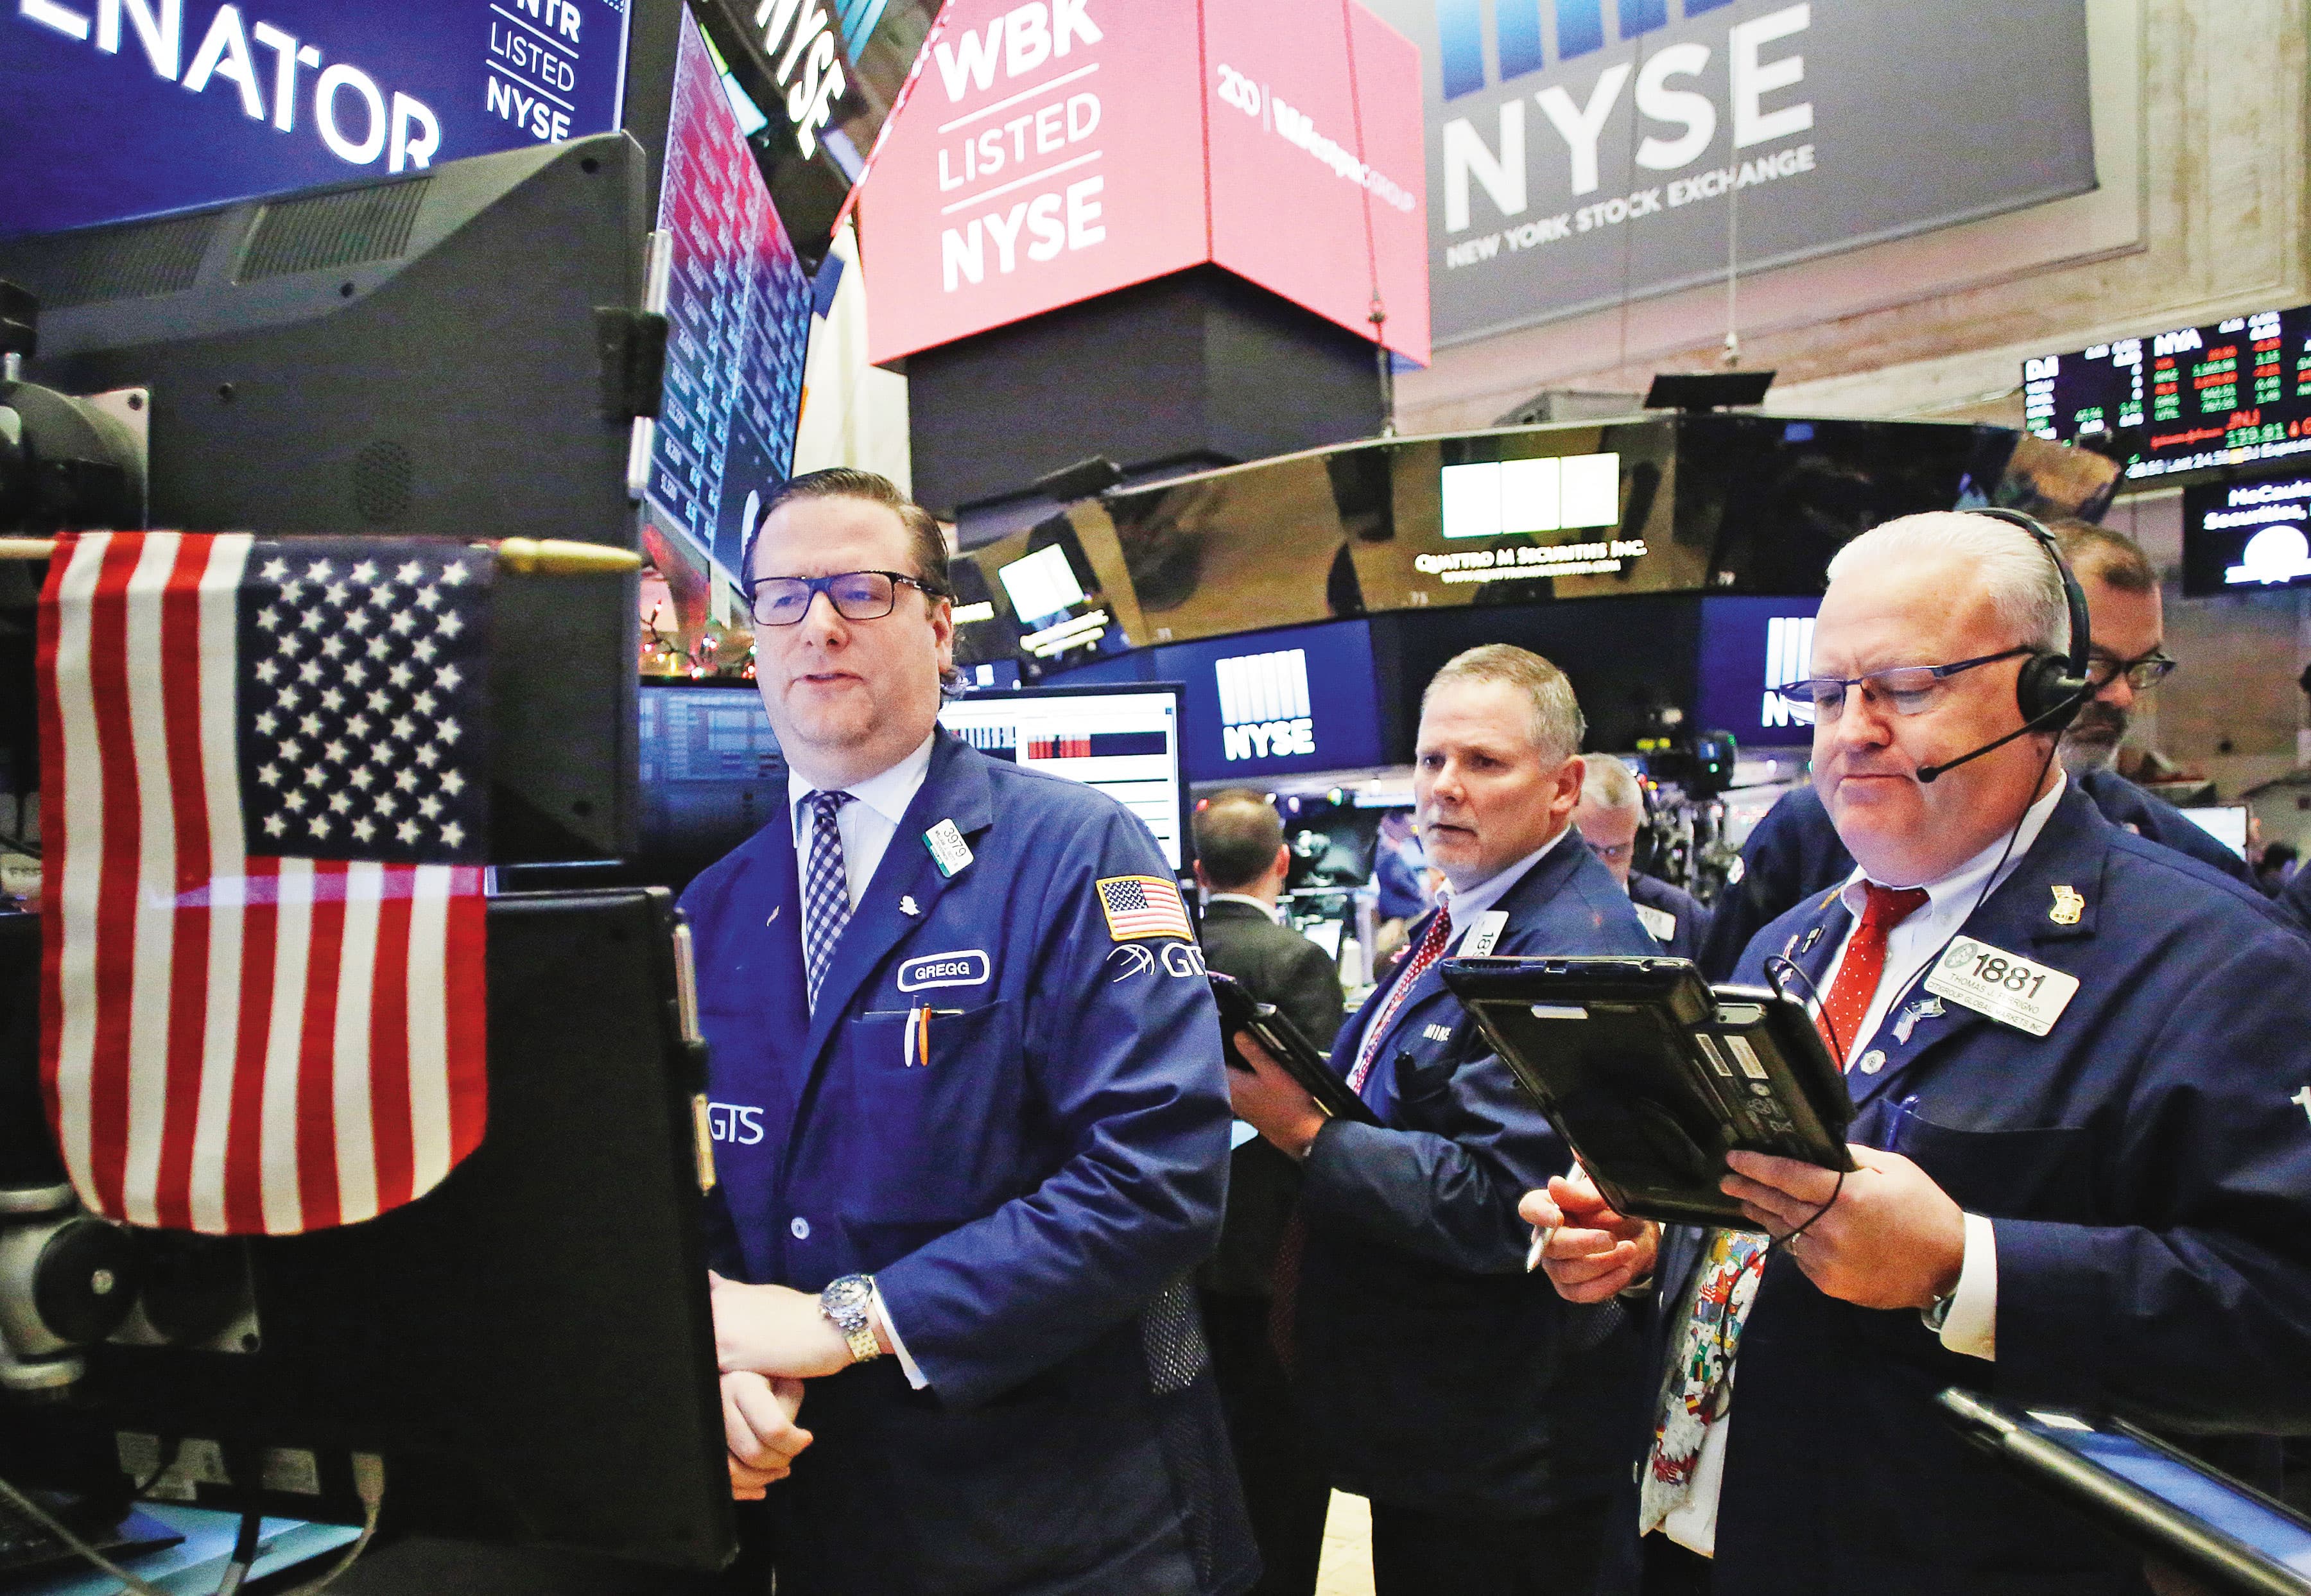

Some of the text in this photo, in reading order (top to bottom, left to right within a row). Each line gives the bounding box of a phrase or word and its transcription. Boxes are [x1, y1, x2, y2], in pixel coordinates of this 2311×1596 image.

[490, 22, 575, 91] LISTED
[933, 0, 1104, 103] WBK
[22, 0, 442, 173] NATOR
[487, 75, 571, 144] NYSE
[939, 92, 1102, 192] LISTED
[1443, 5, 1814, 233] NYSE
[941, 175, 1106, 293] NYSE
[1446, 144, 1817, 269] NEW YORK STOCK EXCHANGE
[1223, 718, 1316, 761] NYSE
[943, 827, 967, 858] 3979
[915, 962, 970, 980] GREGG
[1473, 932, 1494, 957] 18
[1950, 973, 1986, 993] THOMAS
[1972, 953, 2047, 998] 1881
[1423, 1024, 1452, 1042] MIKE
[708, 1102, 765, 1145] GTS
